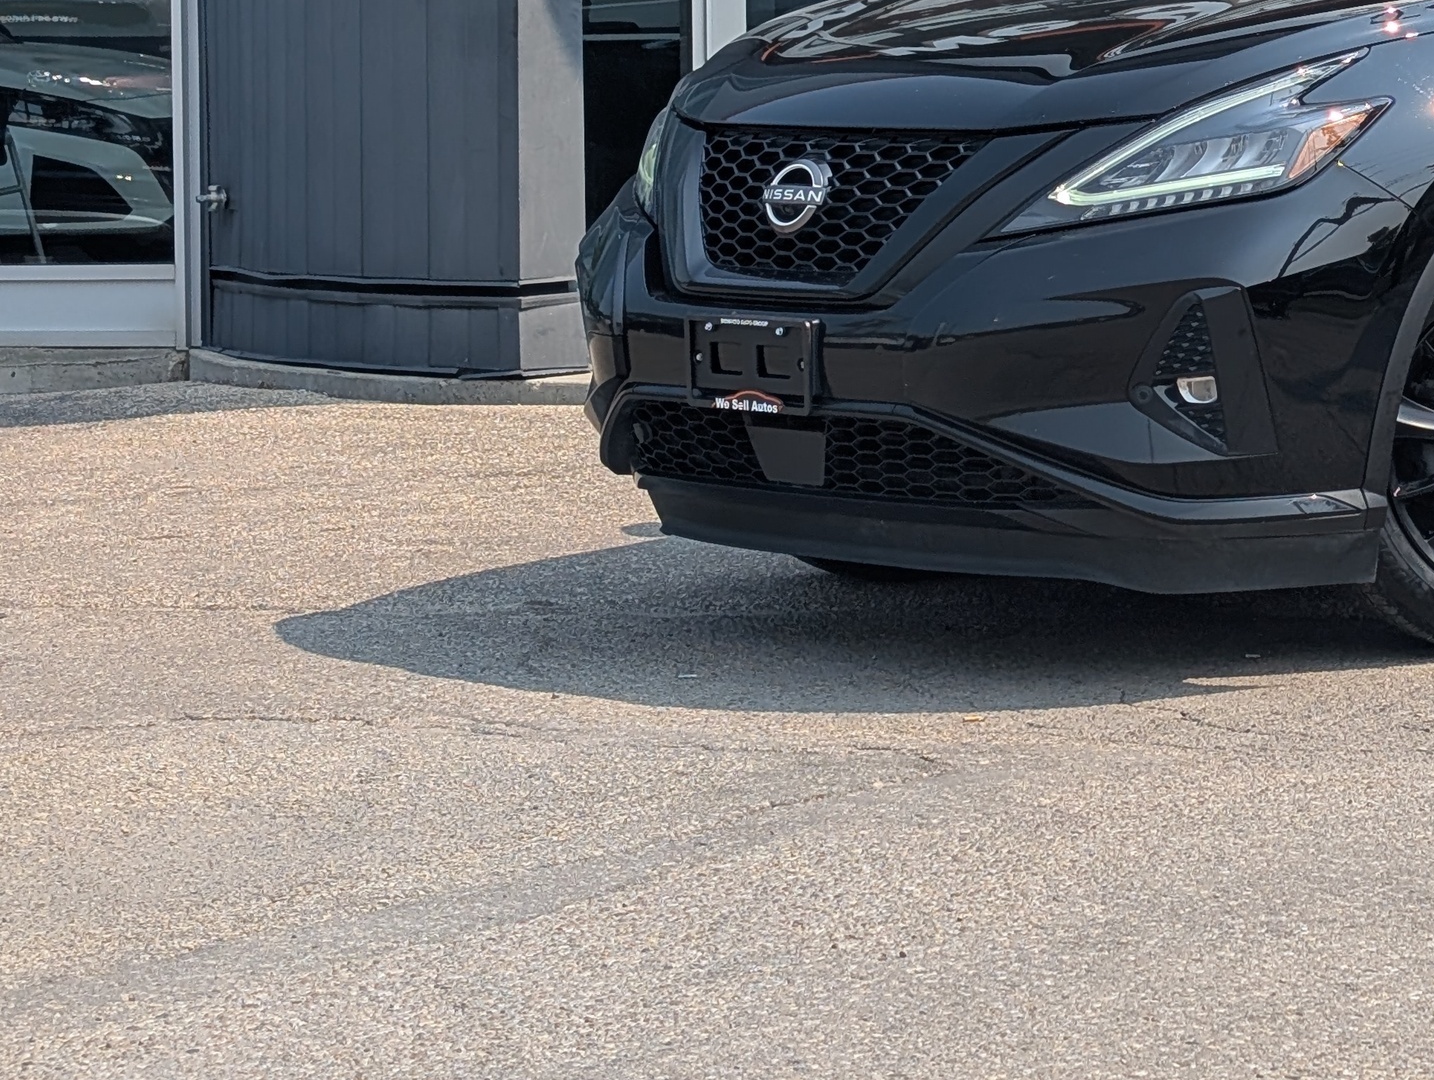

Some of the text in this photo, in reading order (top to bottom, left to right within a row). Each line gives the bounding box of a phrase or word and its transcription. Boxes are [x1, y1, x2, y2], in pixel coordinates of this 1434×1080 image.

[763, 188, 823, 203] NISSAN
[715, 397, 778, 414] We Sell Autos
